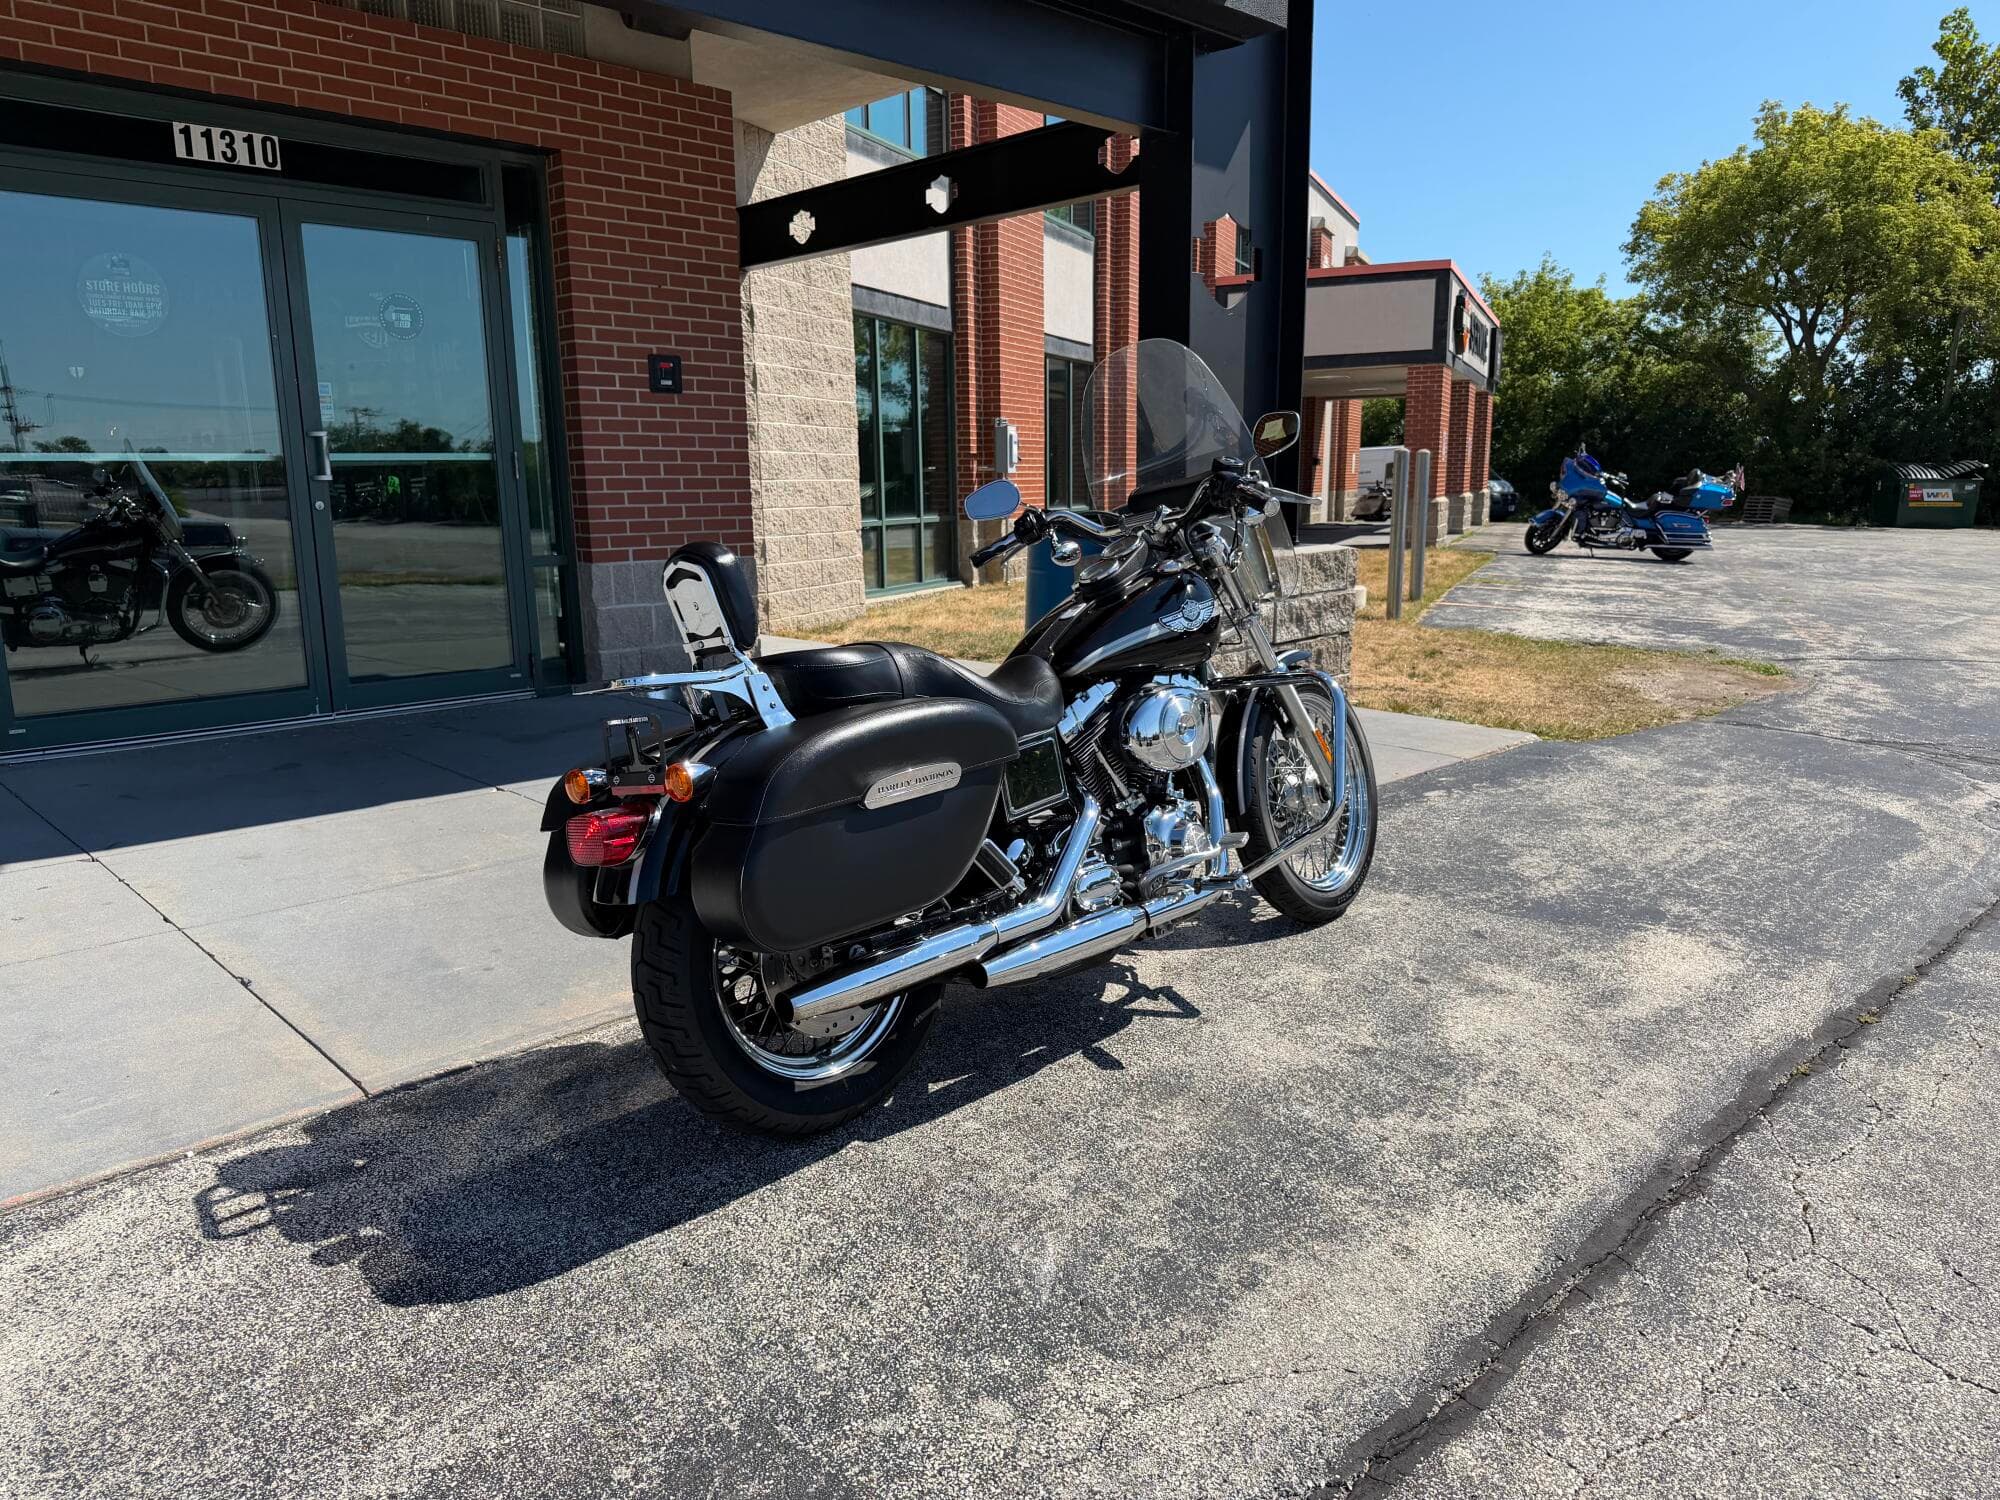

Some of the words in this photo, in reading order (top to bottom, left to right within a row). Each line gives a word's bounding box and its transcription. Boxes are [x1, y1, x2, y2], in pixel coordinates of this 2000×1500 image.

[178, 124, 279, 169] 11310
[86, 280, 120, 293] STORE
[123, 281, 160, 295] HOURS
